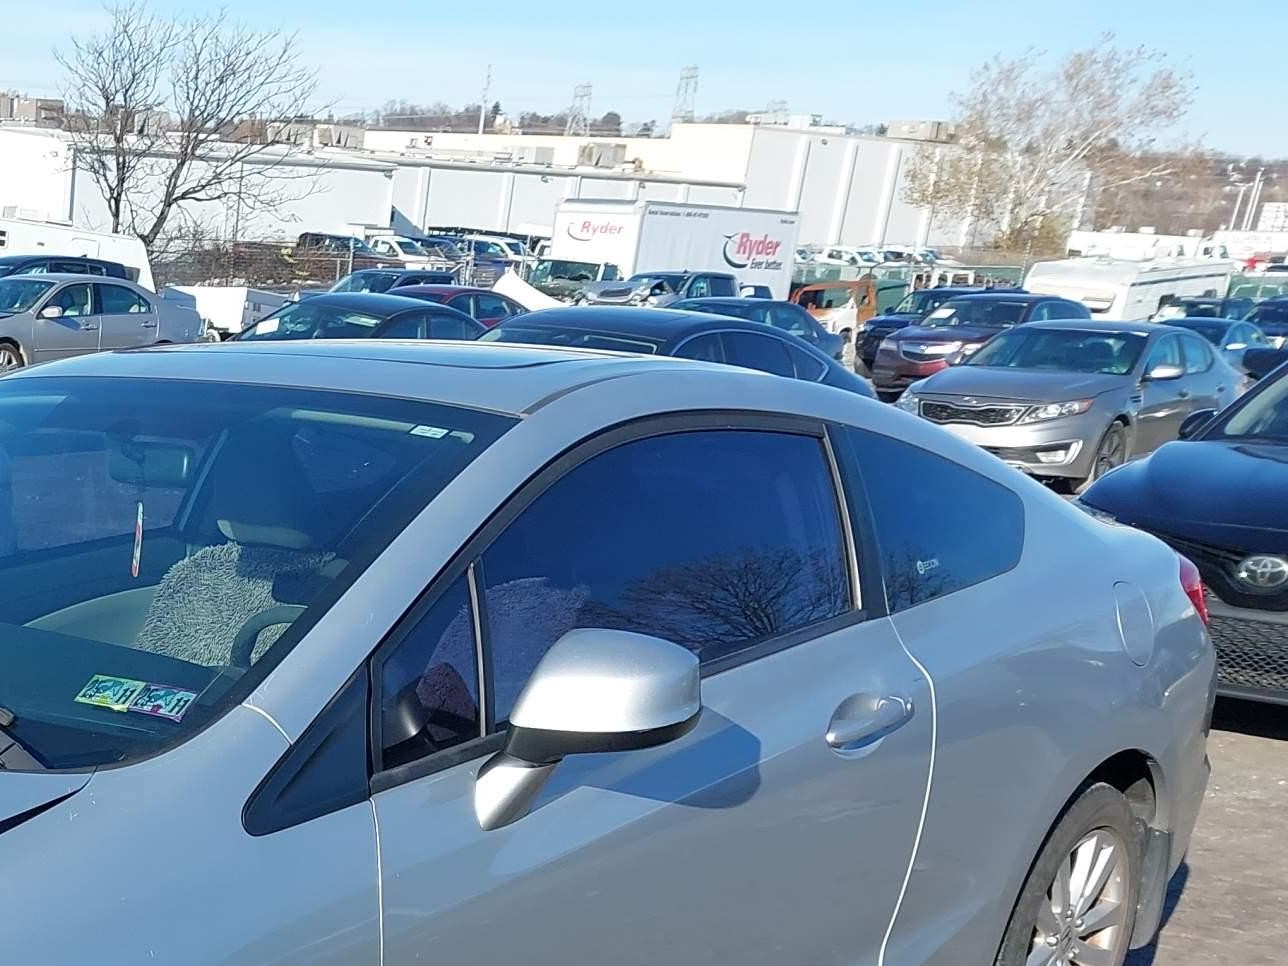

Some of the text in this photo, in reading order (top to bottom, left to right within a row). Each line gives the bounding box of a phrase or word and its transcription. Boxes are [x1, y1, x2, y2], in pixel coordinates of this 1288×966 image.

[580, 220, 624, 236] Ryder
[736, 232, 782, 260] Ryder
[115, 688, 134, 705] 11
[169, 696, 191, 714] 11
